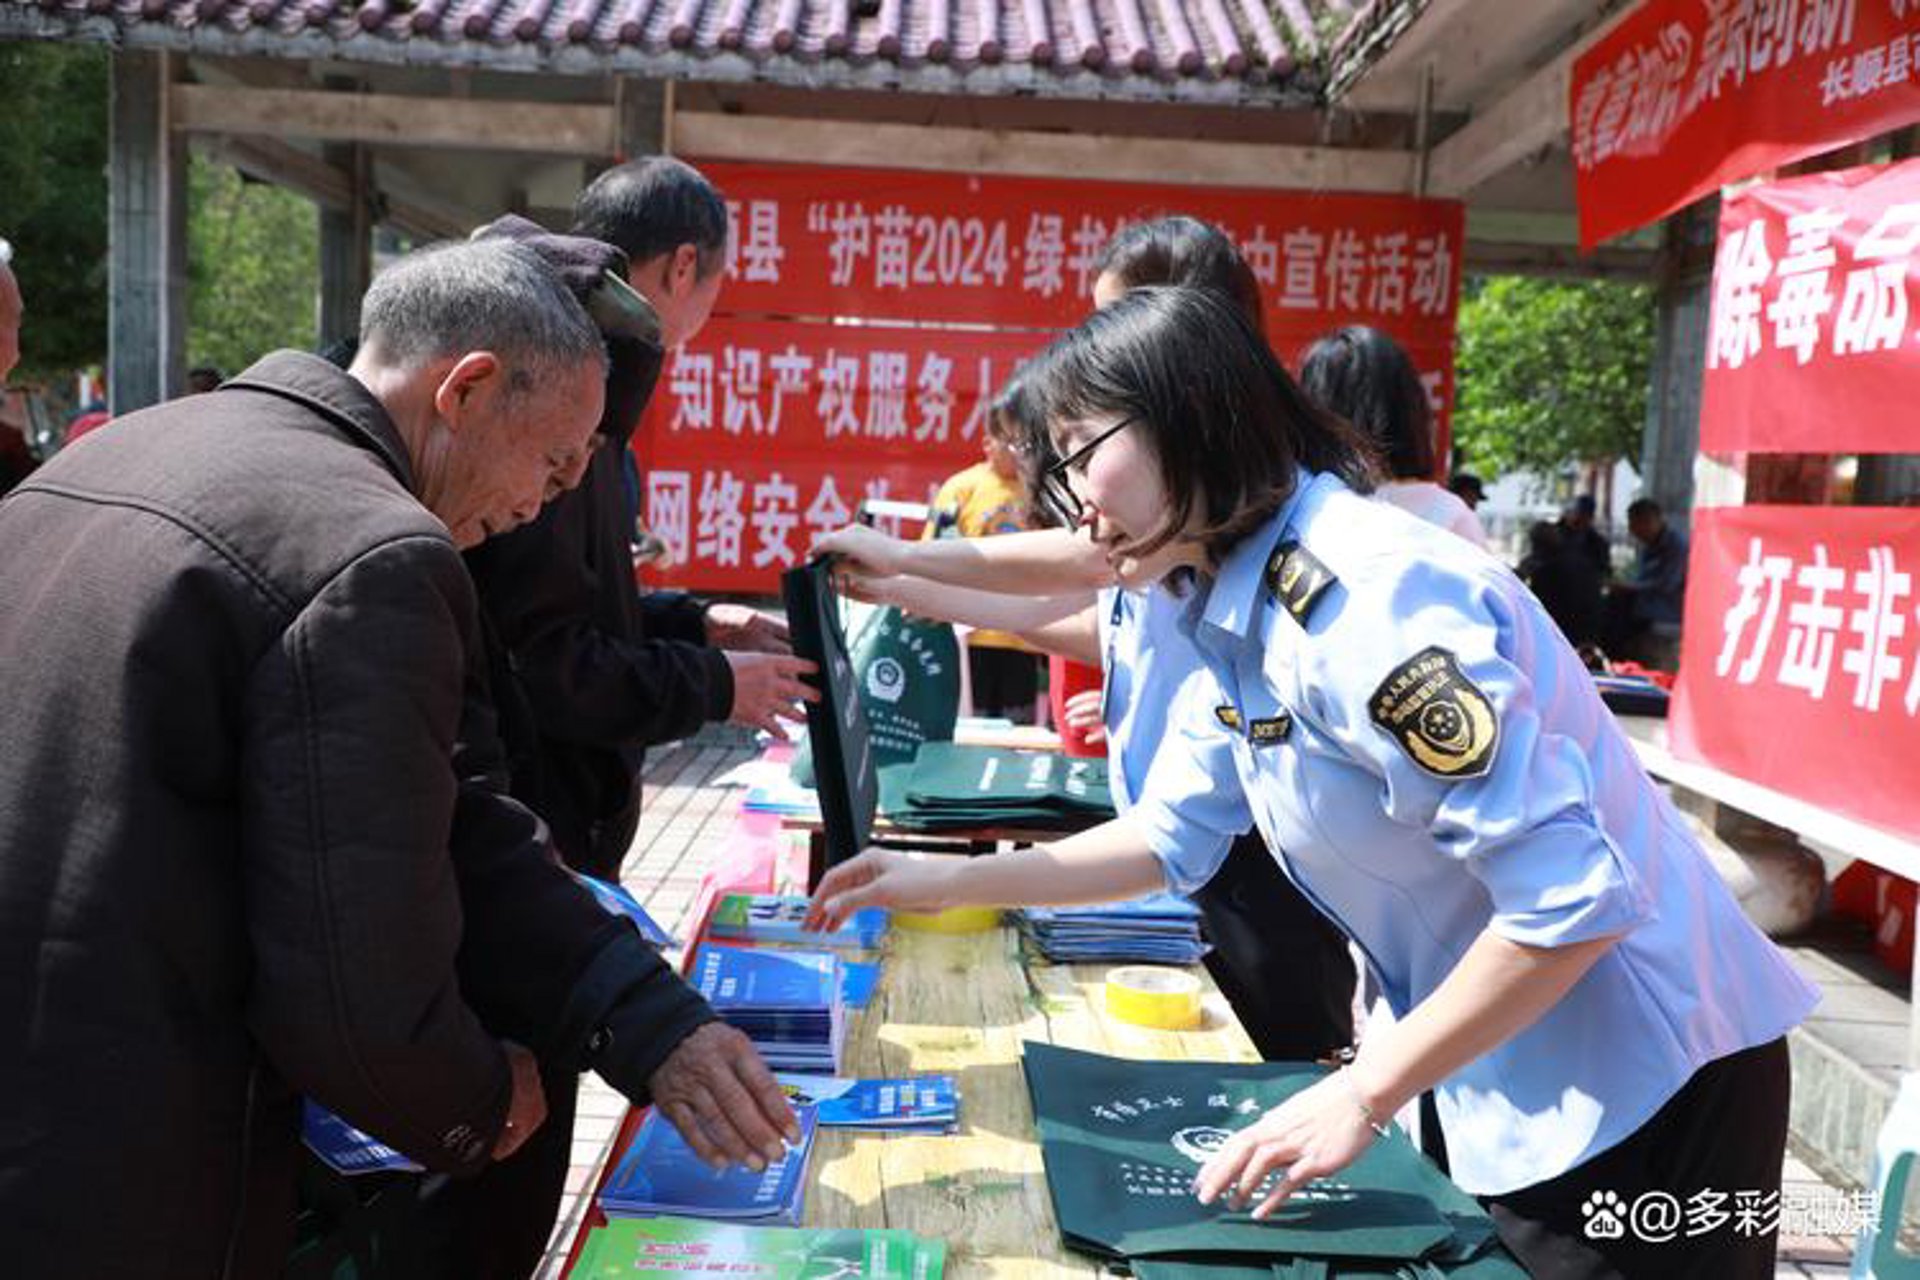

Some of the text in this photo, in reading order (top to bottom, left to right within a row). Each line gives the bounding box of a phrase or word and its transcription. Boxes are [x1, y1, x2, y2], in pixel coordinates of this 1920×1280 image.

[1819, 33, 1920, 106] 长顺县
[1707, 203, 1920, 369] 除毒品
[670, 344, 1022, 443] 知识产权服务人
[647, 470, 941, 568] 网络安全
[1716, 537, 1920, 715] 打击非
